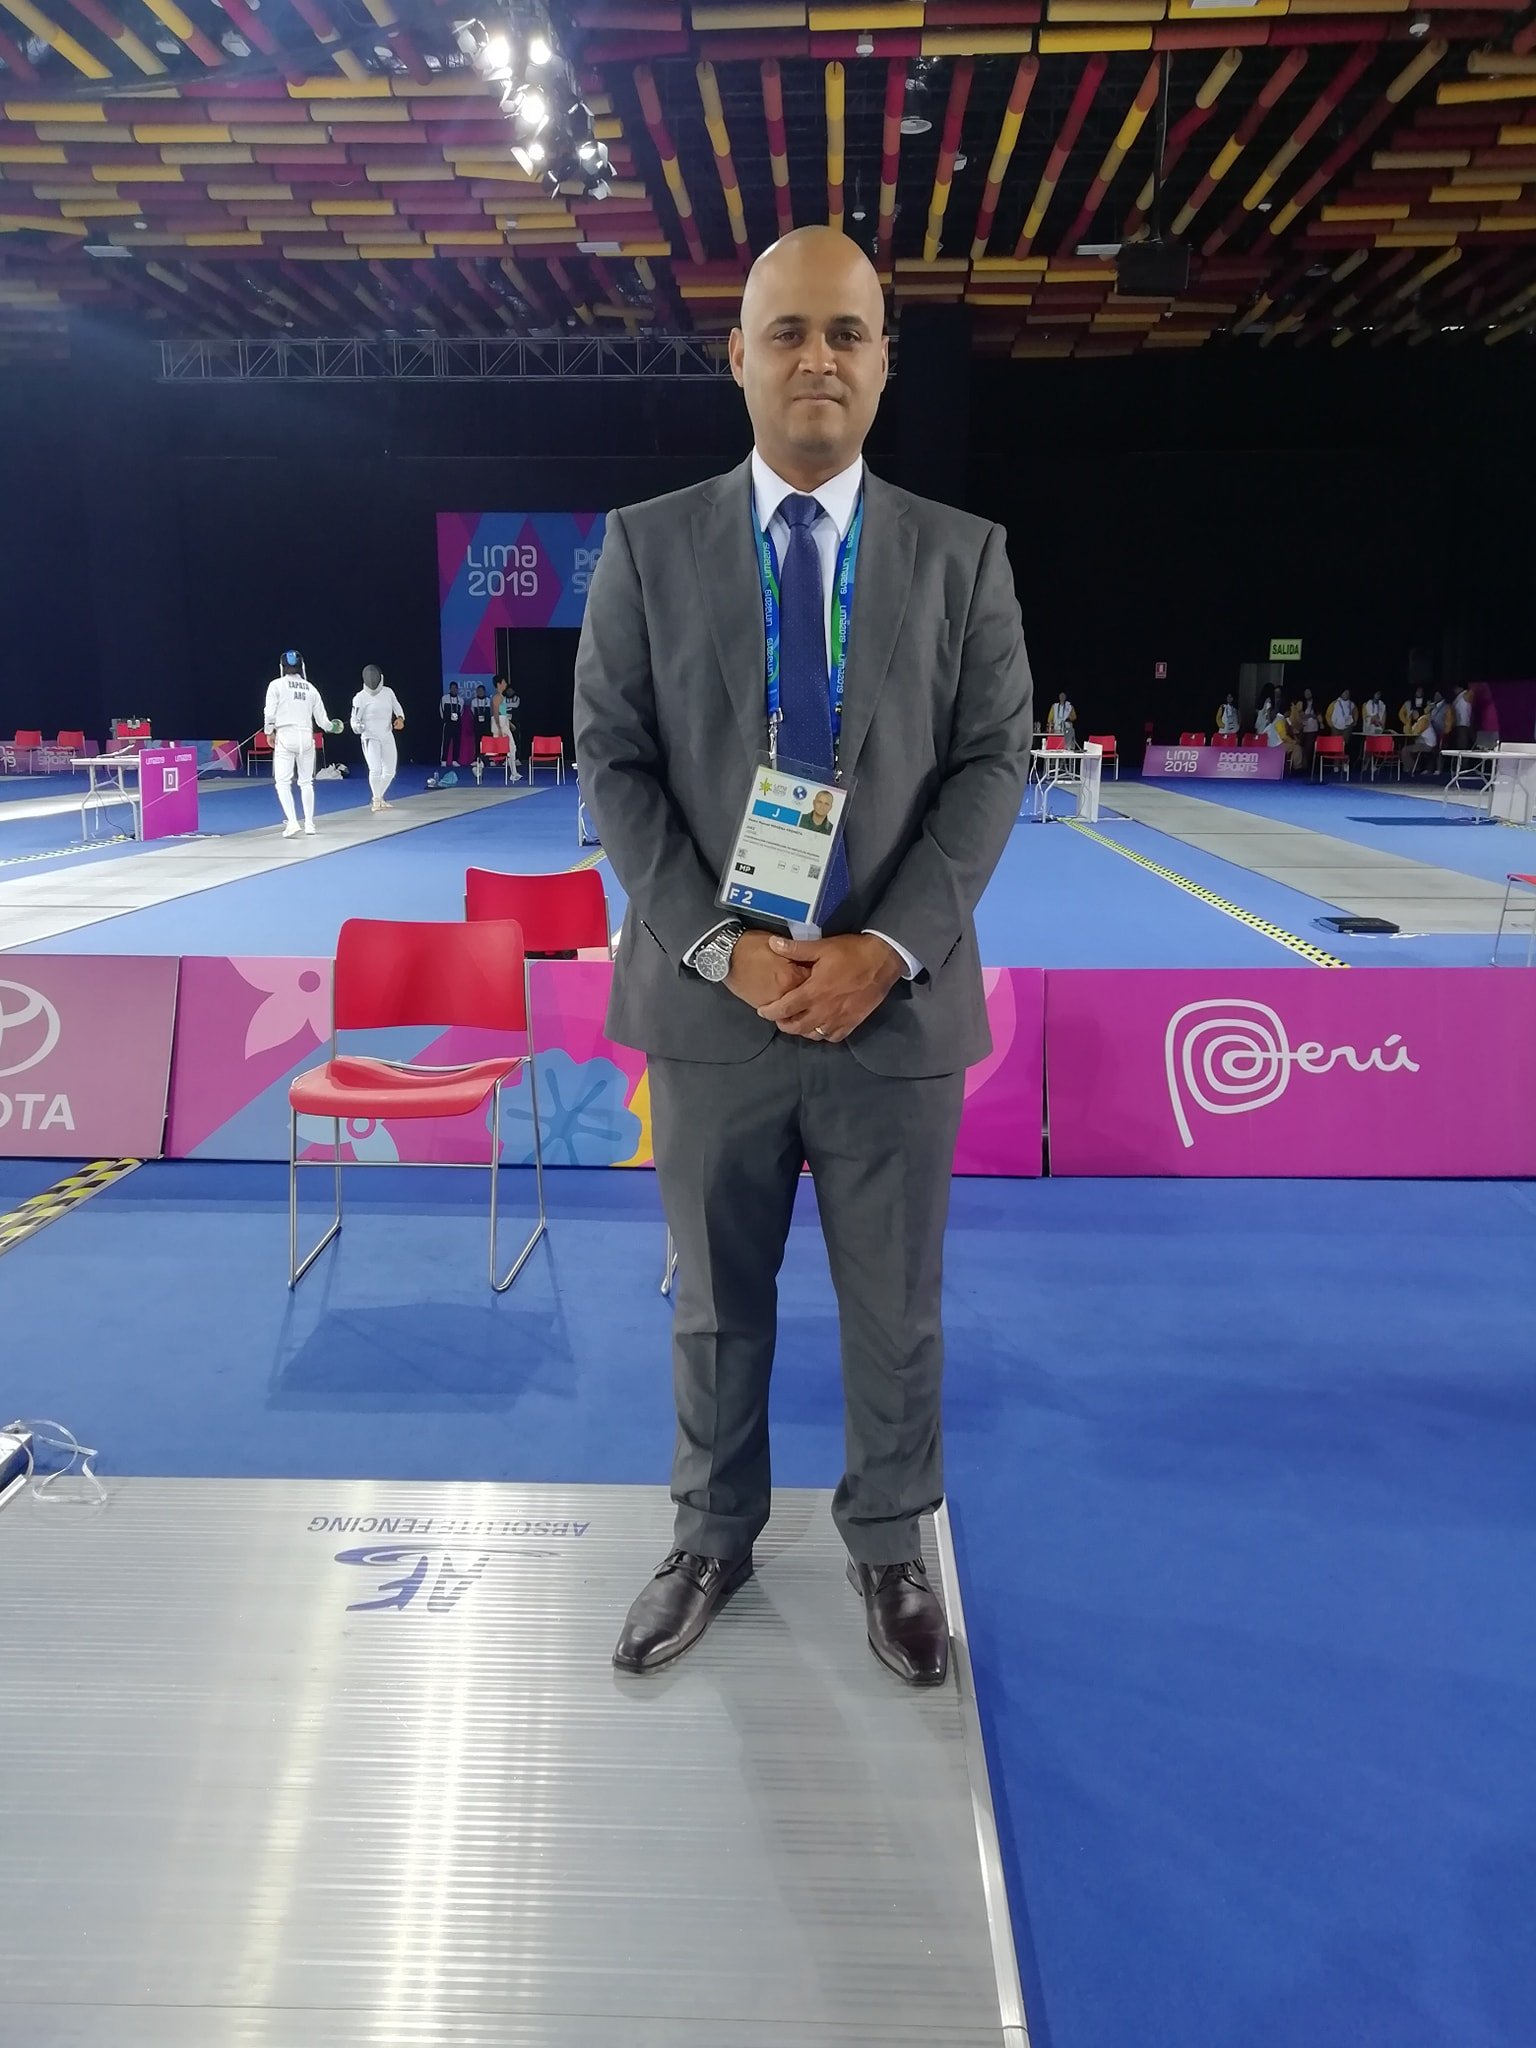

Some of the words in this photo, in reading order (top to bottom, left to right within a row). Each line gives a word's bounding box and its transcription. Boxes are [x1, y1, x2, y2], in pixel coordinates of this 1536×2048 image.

[468, 571, 539, 597] 2019
[1272, 644, 1299, 655] SALIDA
[294, 691, 306, 701] ARG
[1164, 761, 1197, 772] 2019
[1217, 762, 1259, 772] SPORTS
[772, 808, 781, 818] J
[739, 864, 751, 872] MP
[729, 887, 741, 899] F
[741, 890, 753, 904] 2
[1165, 998, 1421, 1149] Perú
[307, 1516, 433, 1534] FENCING
[437, 1518, 591, 1537] ABSOLUTE
